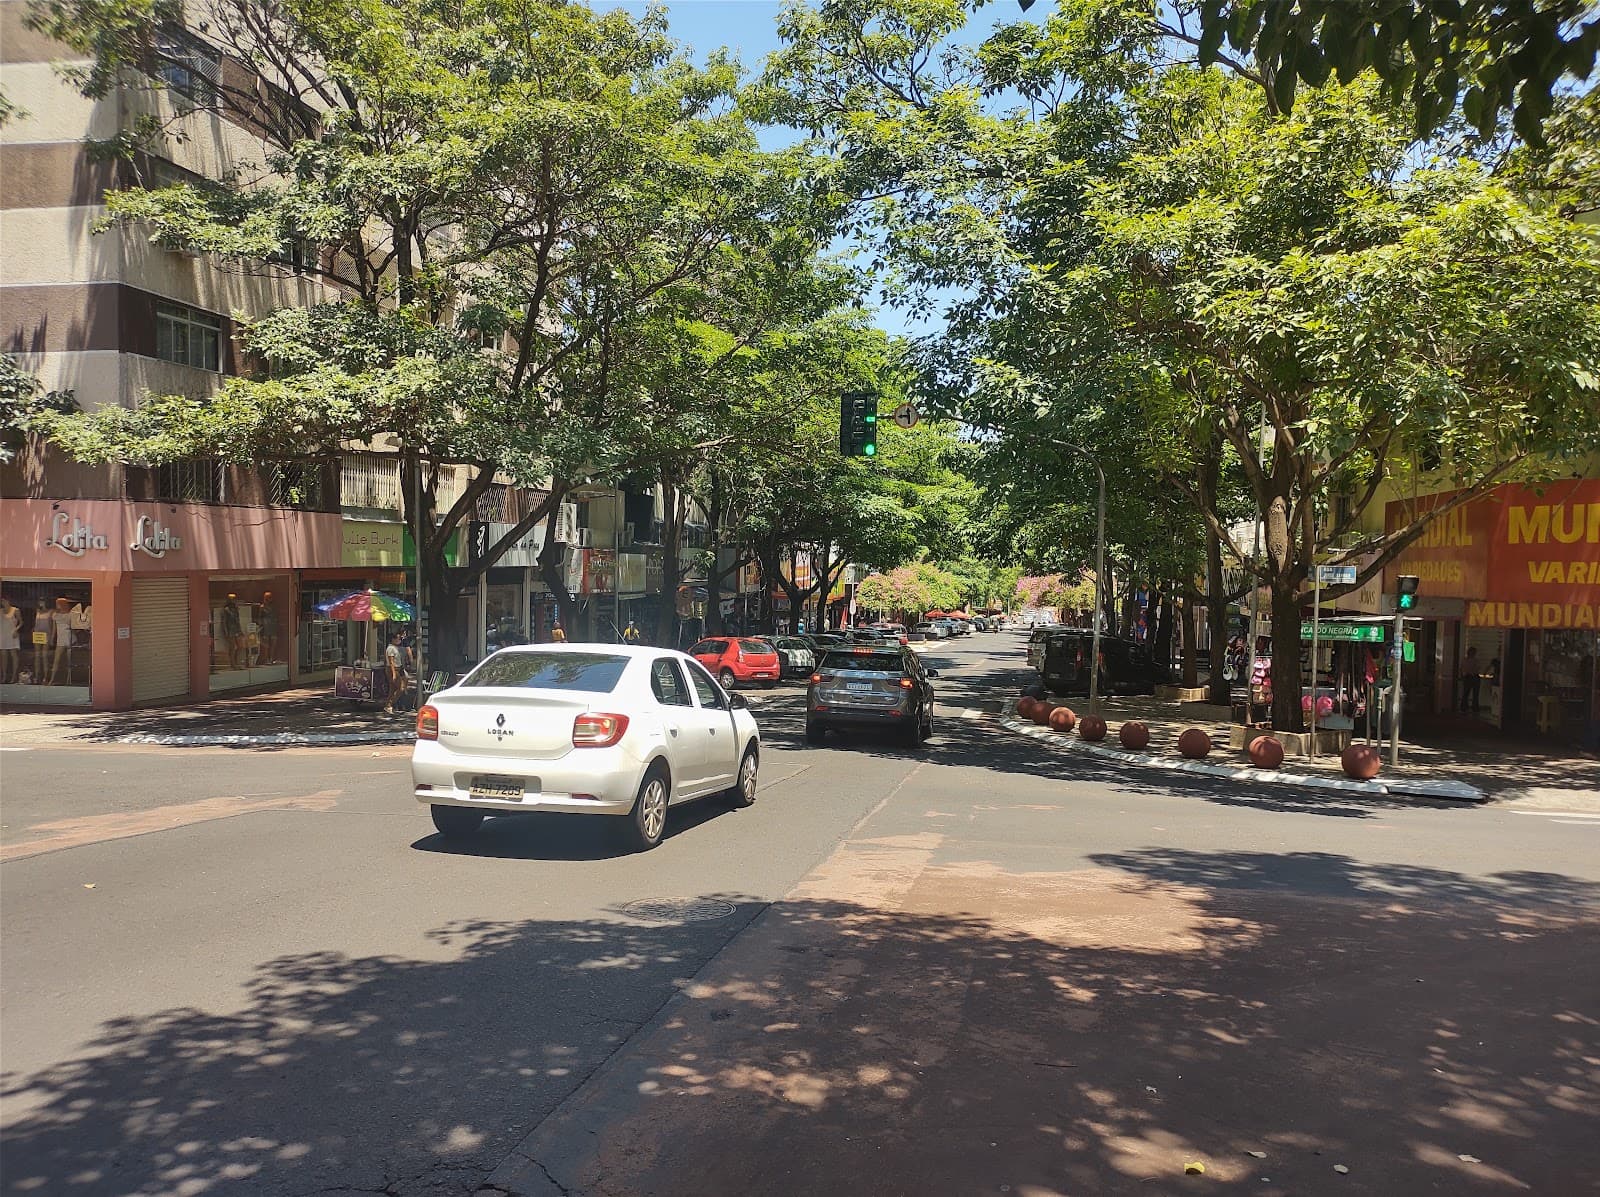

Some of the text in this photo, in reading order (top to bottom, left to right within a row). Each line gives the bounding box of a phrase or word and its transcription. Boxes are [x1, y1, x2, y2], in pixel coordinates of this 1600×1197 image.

[46, 512, 109, 557] Lolita
[130, 515, 182, 558] Lolita
[1528, 561, 1600, 585] VARI
[1469, 602, 1600, 628] MUNDIA
